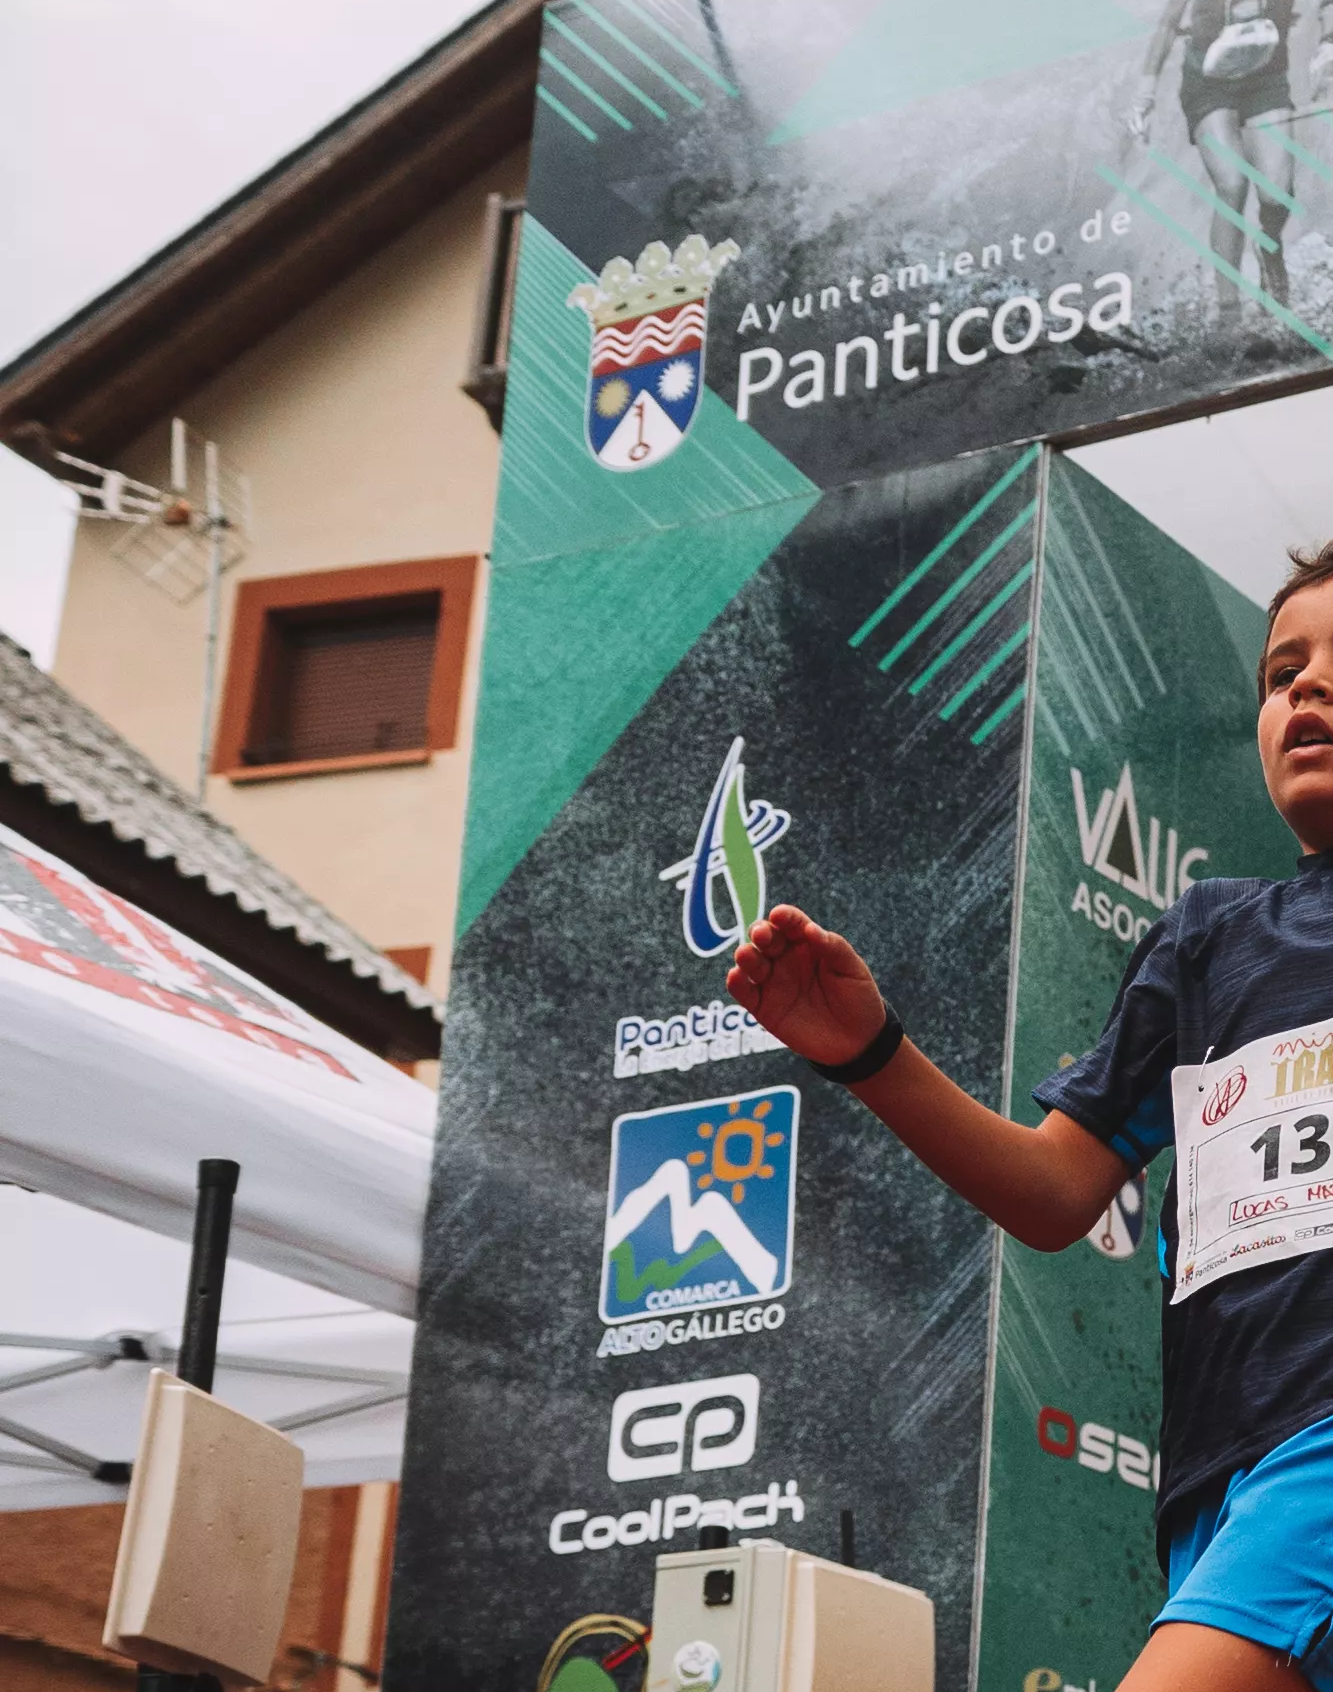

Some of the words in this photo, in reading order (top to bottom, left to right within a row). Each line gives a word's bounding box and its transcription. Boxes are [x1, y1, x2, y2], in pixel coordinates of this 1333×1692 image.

[736, 230, 1056, 334] Ayuntamiento
[1080, 209, 1132, 243] de
[736, 271, 1133, 423] Panticosa
[1231, 1195, 1289, 1221] LUCAS
[1230, 1235, 1287, 1258] Lacasitos
[645, 1279, 741, 1310] COMARCA
